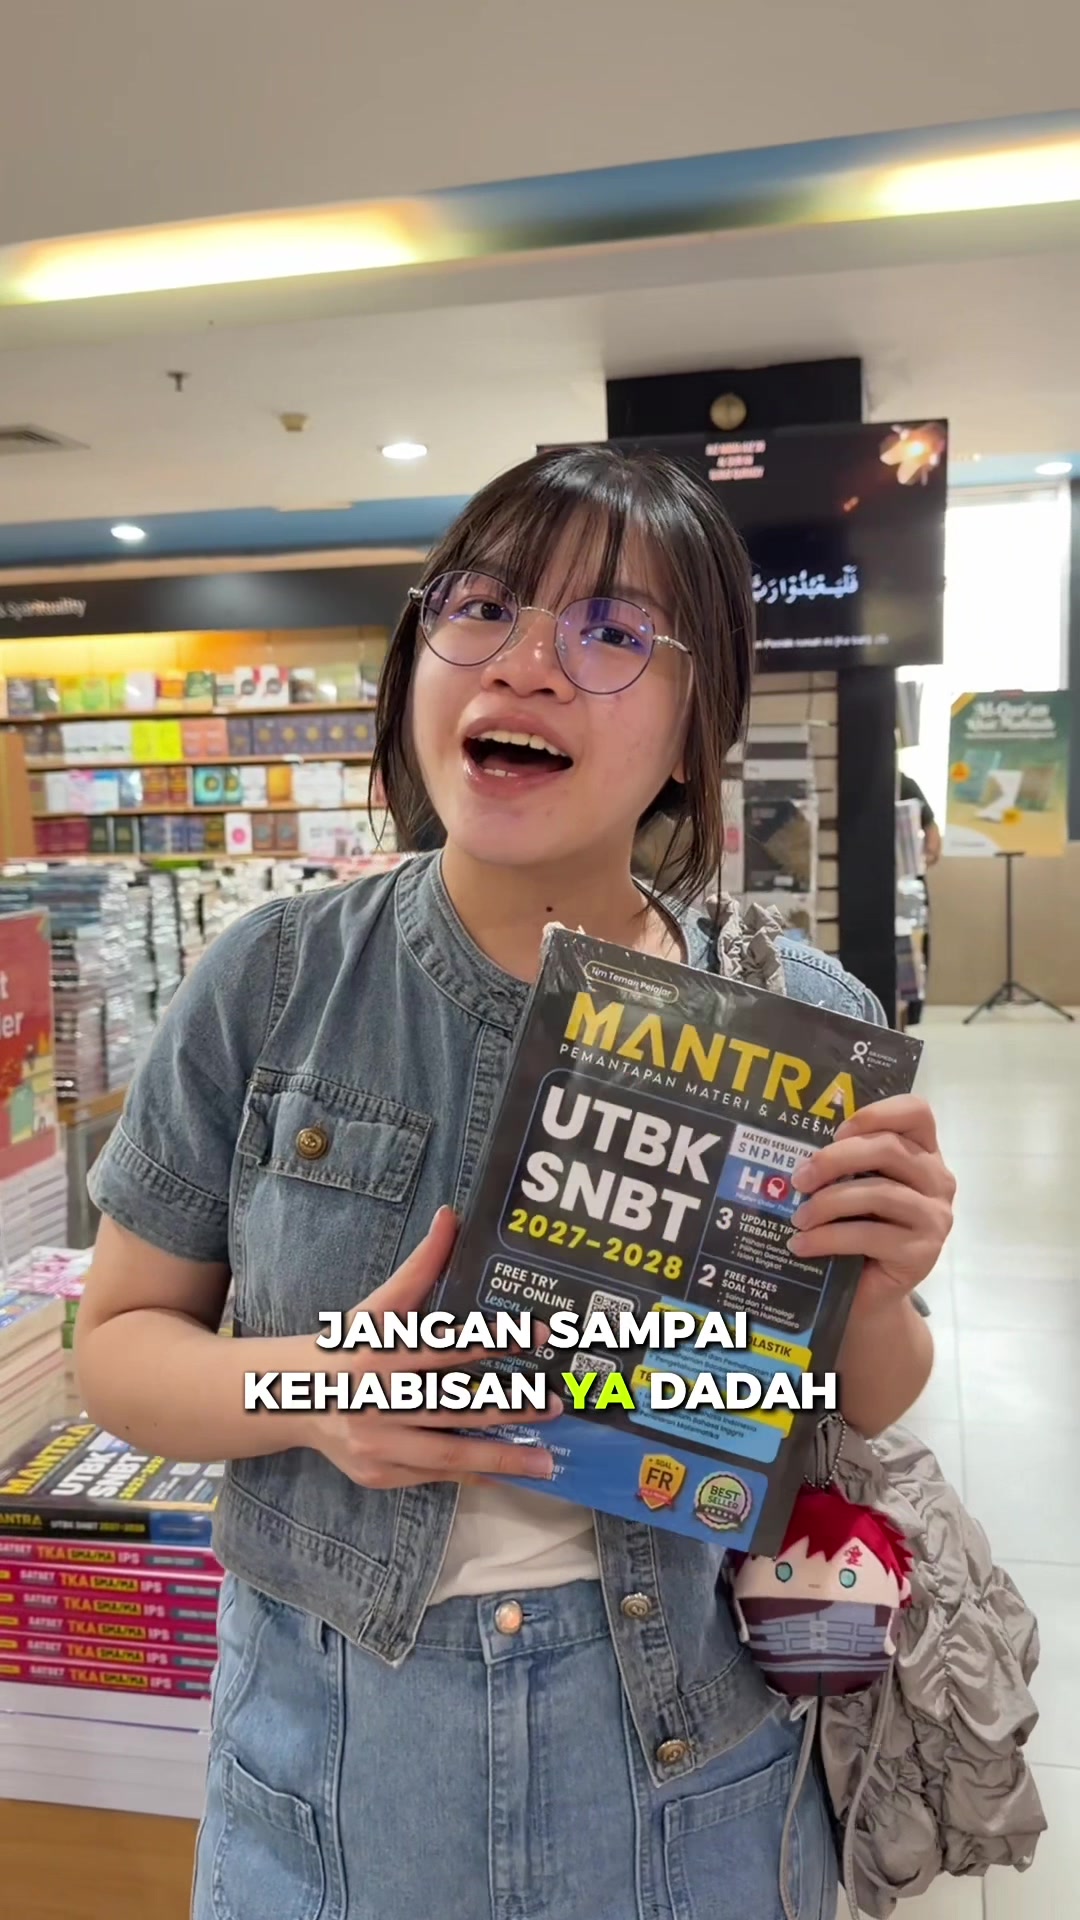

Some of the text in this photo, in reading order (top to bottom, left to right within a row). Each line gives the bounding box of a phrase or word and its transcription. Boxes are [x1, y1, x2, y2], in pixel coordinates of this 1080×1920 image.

[608, 969, 639, 988] Teman
[640, 982, 673, 999] Pelajar
[564, 991, 857, 1121] MANTRA
[559, 1043, 836, 1138] PEMANTAPAN MATERI & ASESM
[542, 1085, 722, 1185] UTBK
[742, 1131, 813, 1159] MATERI SESUAI FRA
[738, 1142, 796, 1169] SNPMB
[521, 1151, 702, 1243] SNBT
[716, 1207, 734, 1230] 3
[741, 1212, 777, 1231] UPDATE
[508, 1208, 684, 1280] 2027-2028
[739, 1222, 781, 1242] TERBARU
[741, 1236, 765, 1249] Pilihan
[736, 1251, 782, 1272] Isian Singkat
[739, 1244, 823, 1276] Pilihan Ganda Kompleks
[494, 1262, 559, 1290] FREE TRY
[698, 1264, 717, 1288] 2
[724, 1269, 778, 1293] FREE AKSES
[490, 1276, 575, 1312] OUT ONLINE
[721, 1280, 769, 1301] SOAL TKA
[723, 1300, 800, 1329] Sosial dan Humaniora
[725, 1293, 795, 1320] Sains dan Teknologi
[750, 1335, 793, 1358] LASTIK
[0, 1423, 96, 1495] MANTRA
[51, 1451, 118, 1496] UTBK
[86, 1451, 149, 1497] SNBT
[645, 1466, 674, 1492] FR
[707, 1495, 740, 1510] SELLER
[710, 1485, 741, 1502] BEST
[37, 1545, 65, 1559] TKA
[117, 1551, 139, 1564] IPS
[61, 1573, 89, 1587] TKA
[141, 1579, 163, 1592] IPS
[64, 1597, 92, 1611] TKA
[144, 1603, 166, 1616] IPS
[69, 1620, 97, 1634] TKA
[149, 1626, 171, 1639] IPS
[67, 1644, 95, 1658] TKA
[147, 1650, 169, 1663] IPS
[71, 1669, 99, 1683] TKA
[151, 1675, 173, 1688] IPS
